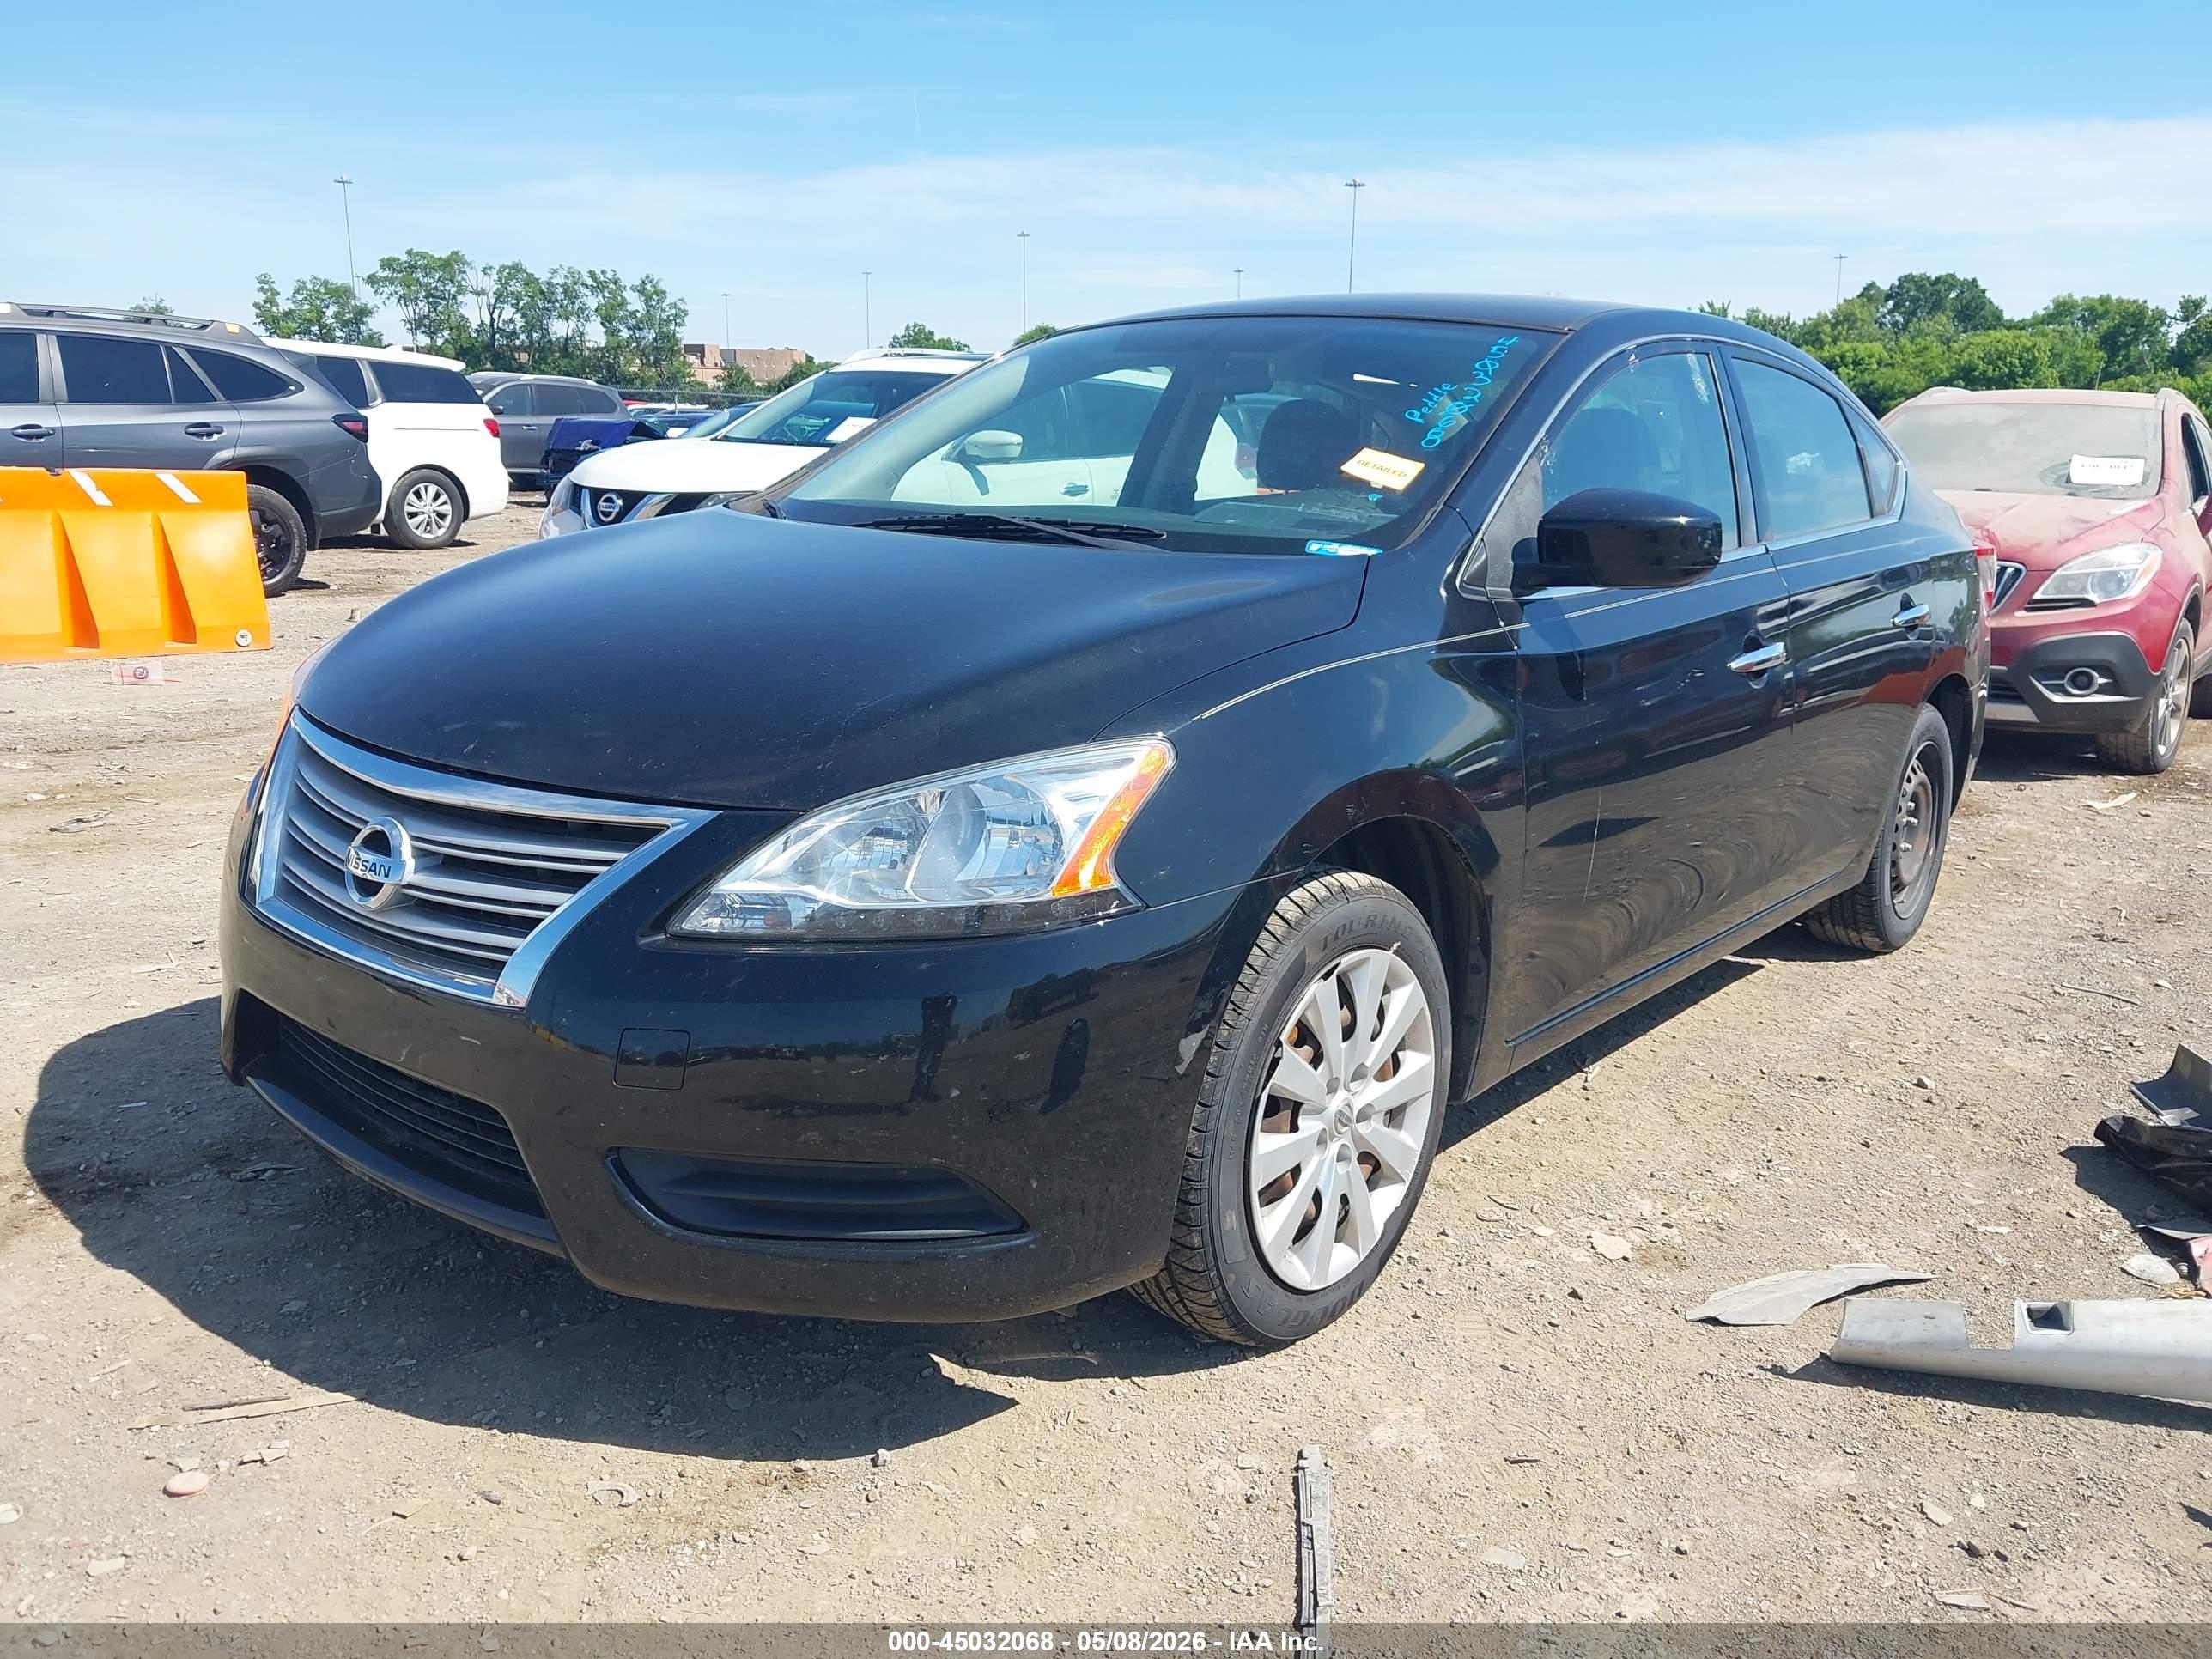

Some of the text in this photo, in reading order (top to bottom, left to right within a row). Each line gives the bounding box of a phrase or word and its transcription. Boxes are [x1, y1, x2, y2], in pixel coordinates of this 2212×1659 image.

[1405, 381, 1458, 424] Peddle
[1356, 459, 1407, 477] DETAILED
[346, 849, 392, 878] NISSAN
